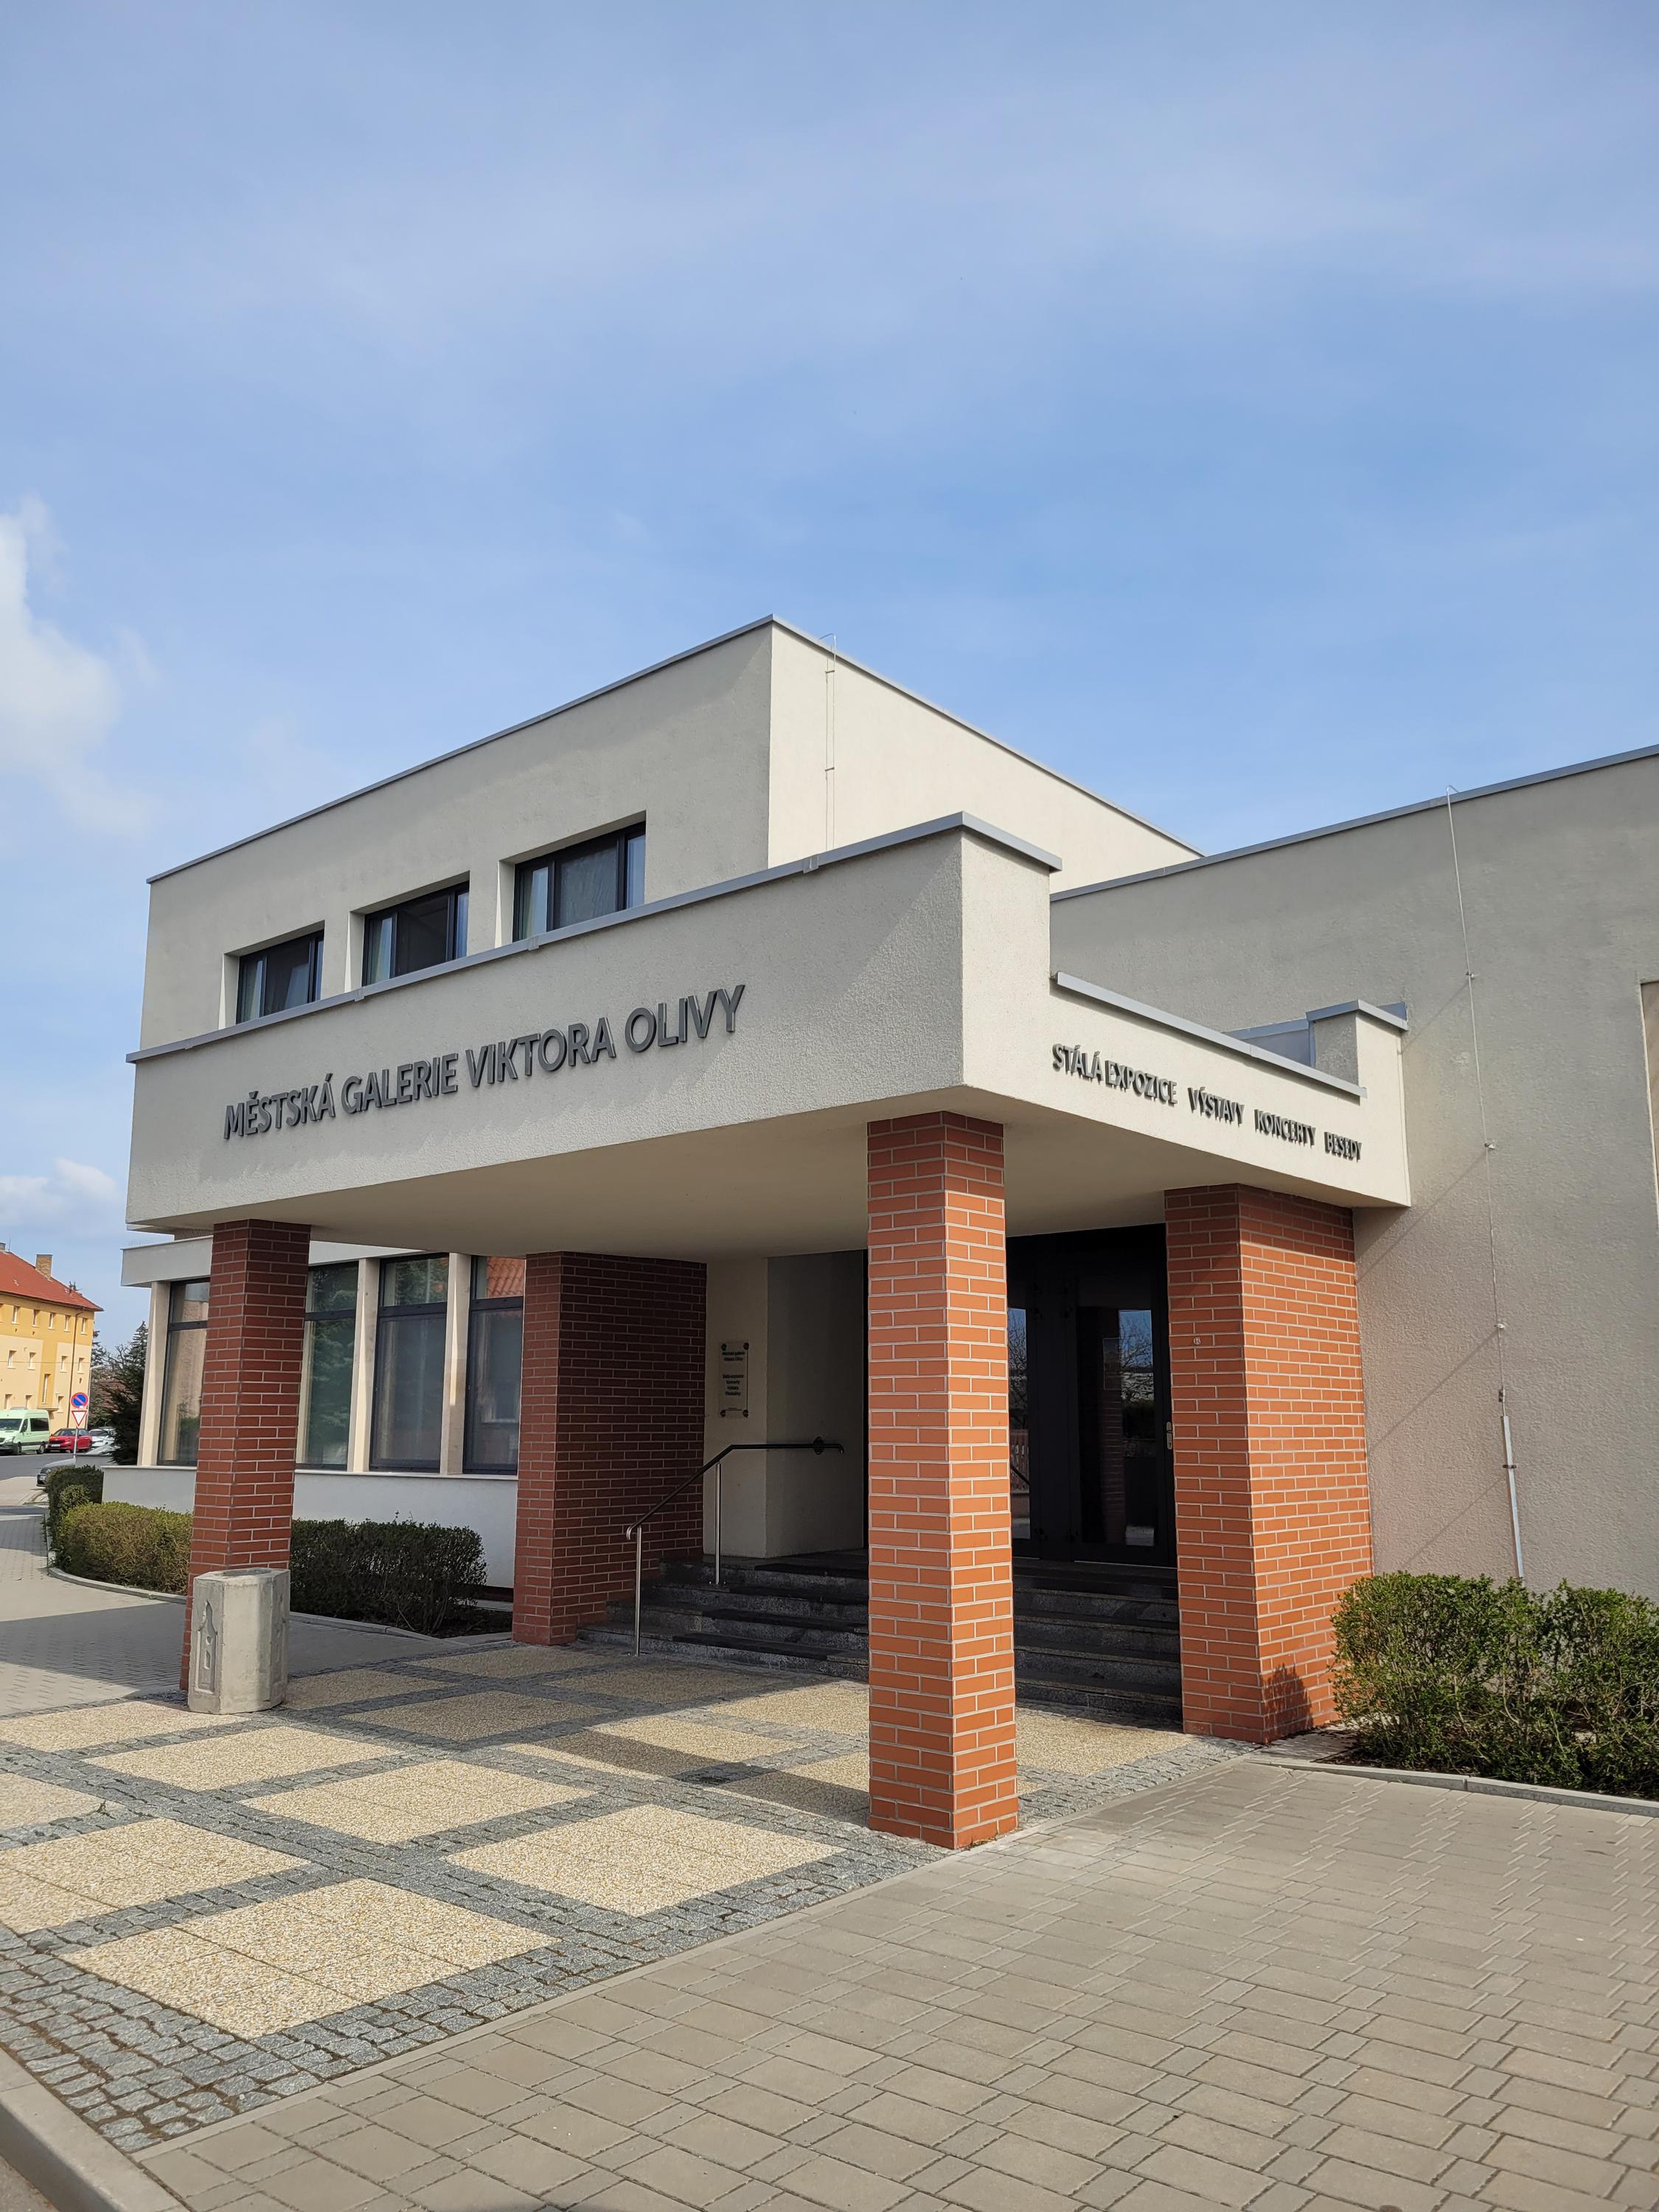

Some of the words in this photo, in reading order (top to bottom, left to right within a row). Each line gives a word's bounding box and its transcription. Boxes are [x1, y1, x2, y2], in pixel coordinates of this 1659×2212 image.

[223, 1073, 336, 1139] MĚSTSKÁ
[341, 1053, 459, 1114] GALERIE
[465, 1016, 617, 1088] VIKTORA
[625, 984, 745, 1053] OLIVY
[1052, 1043, 1104, 1082] STÁLÁ
[1105, 1060, 1178, 1105] EXPOZICE
[1187, 1086, 1245, 1125] VÝSTAVY
[1254, 1109, 1316, 1147] KONCERTY
[1324, 1131, 1362, 1161] BESEDY
